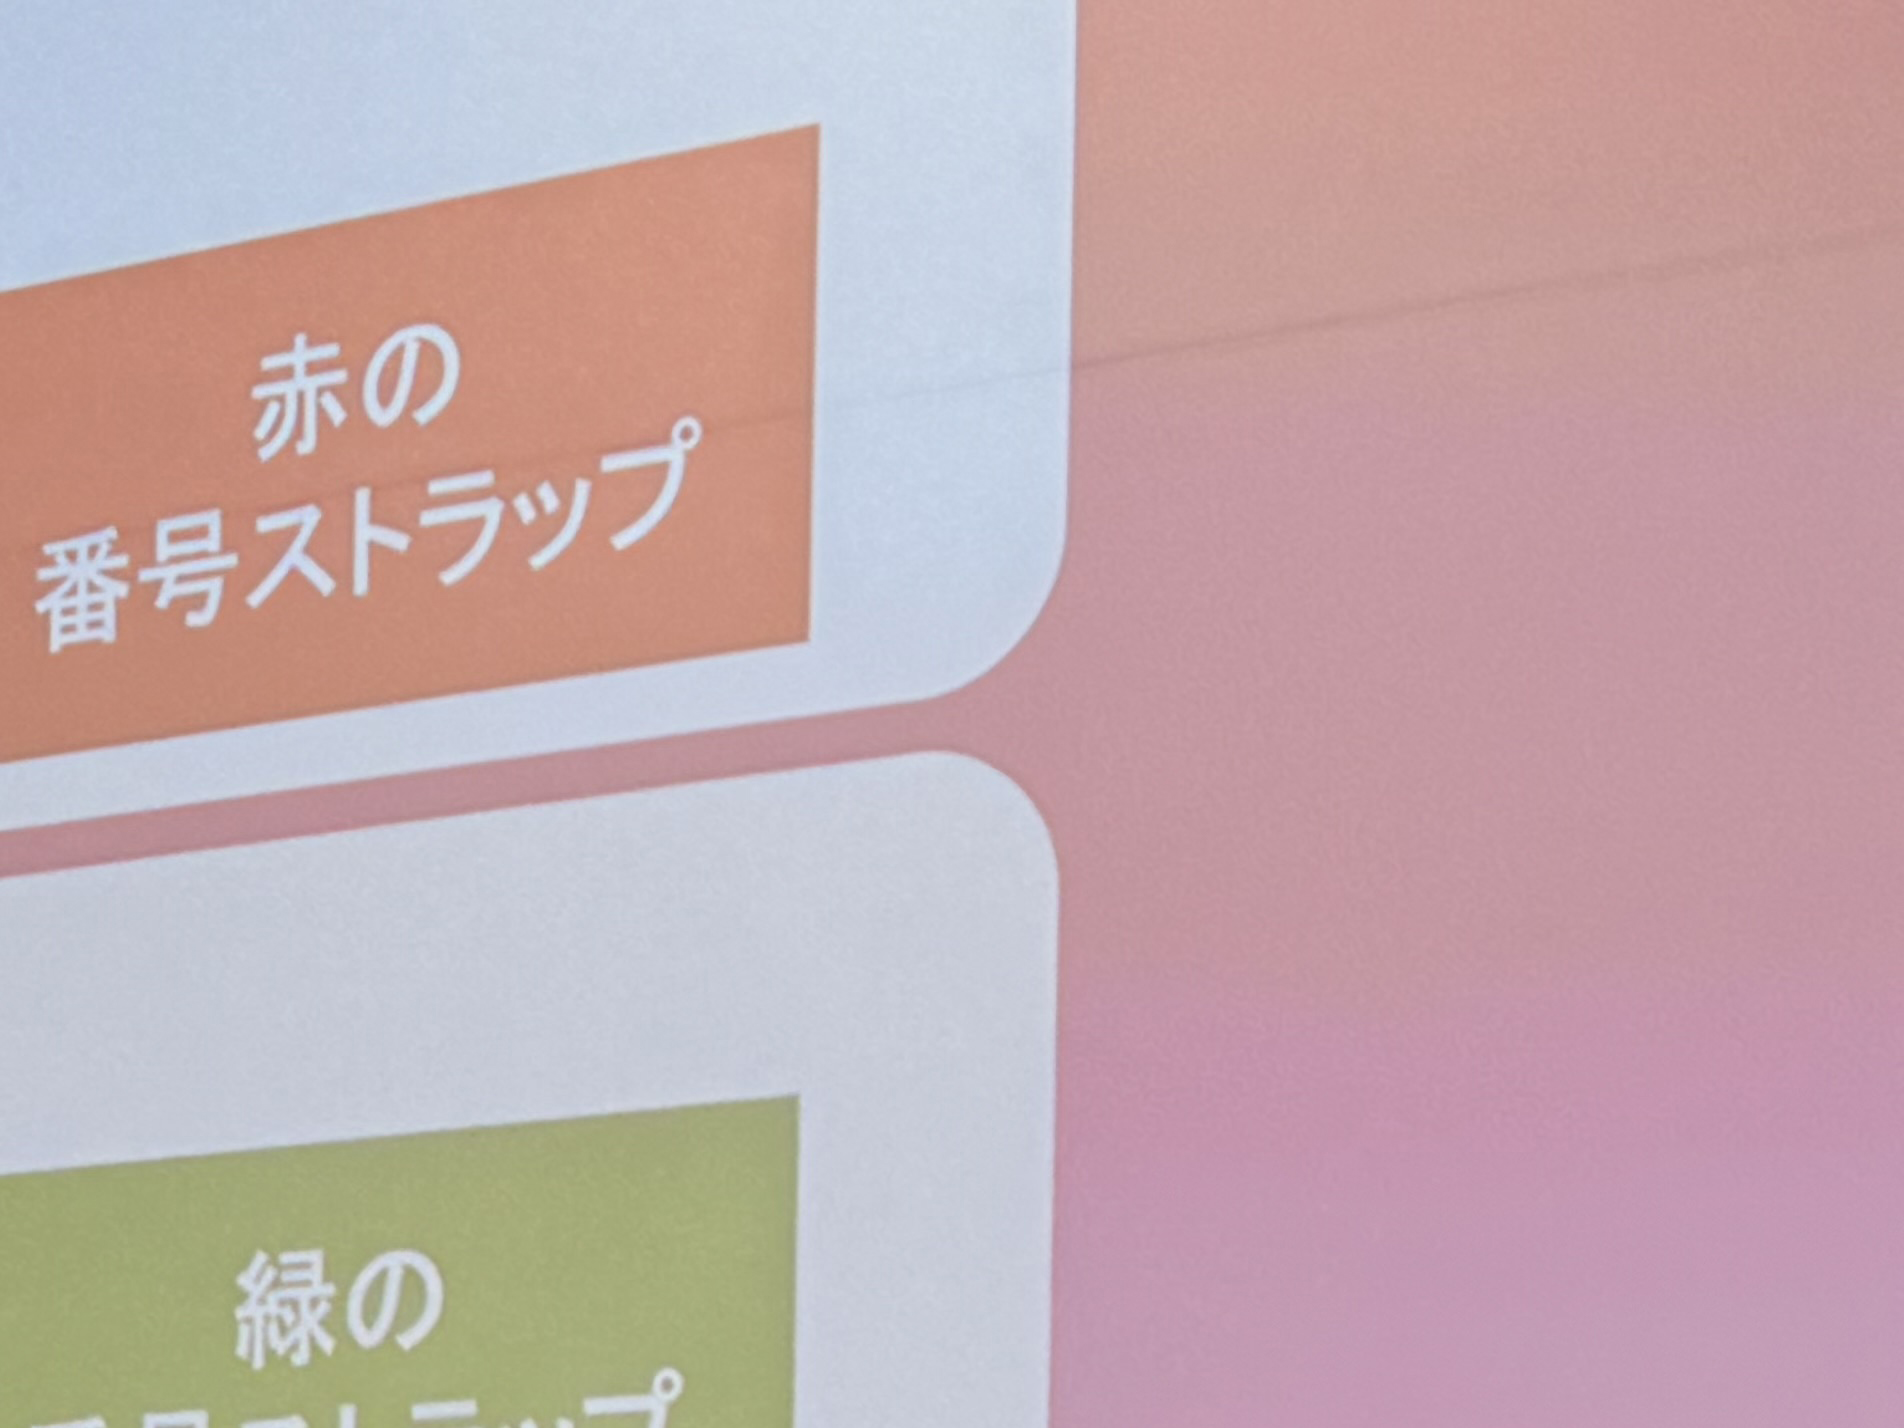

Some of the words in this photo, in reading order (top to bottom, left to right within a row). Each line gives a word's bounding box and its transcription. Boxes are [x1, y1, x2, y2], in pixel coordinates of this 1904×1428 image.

[251, 321, 460, 462] 赤の
[33, 415, 701, 654] 番号ストラップ
[234, 1245, 444, 1373] 緑の
